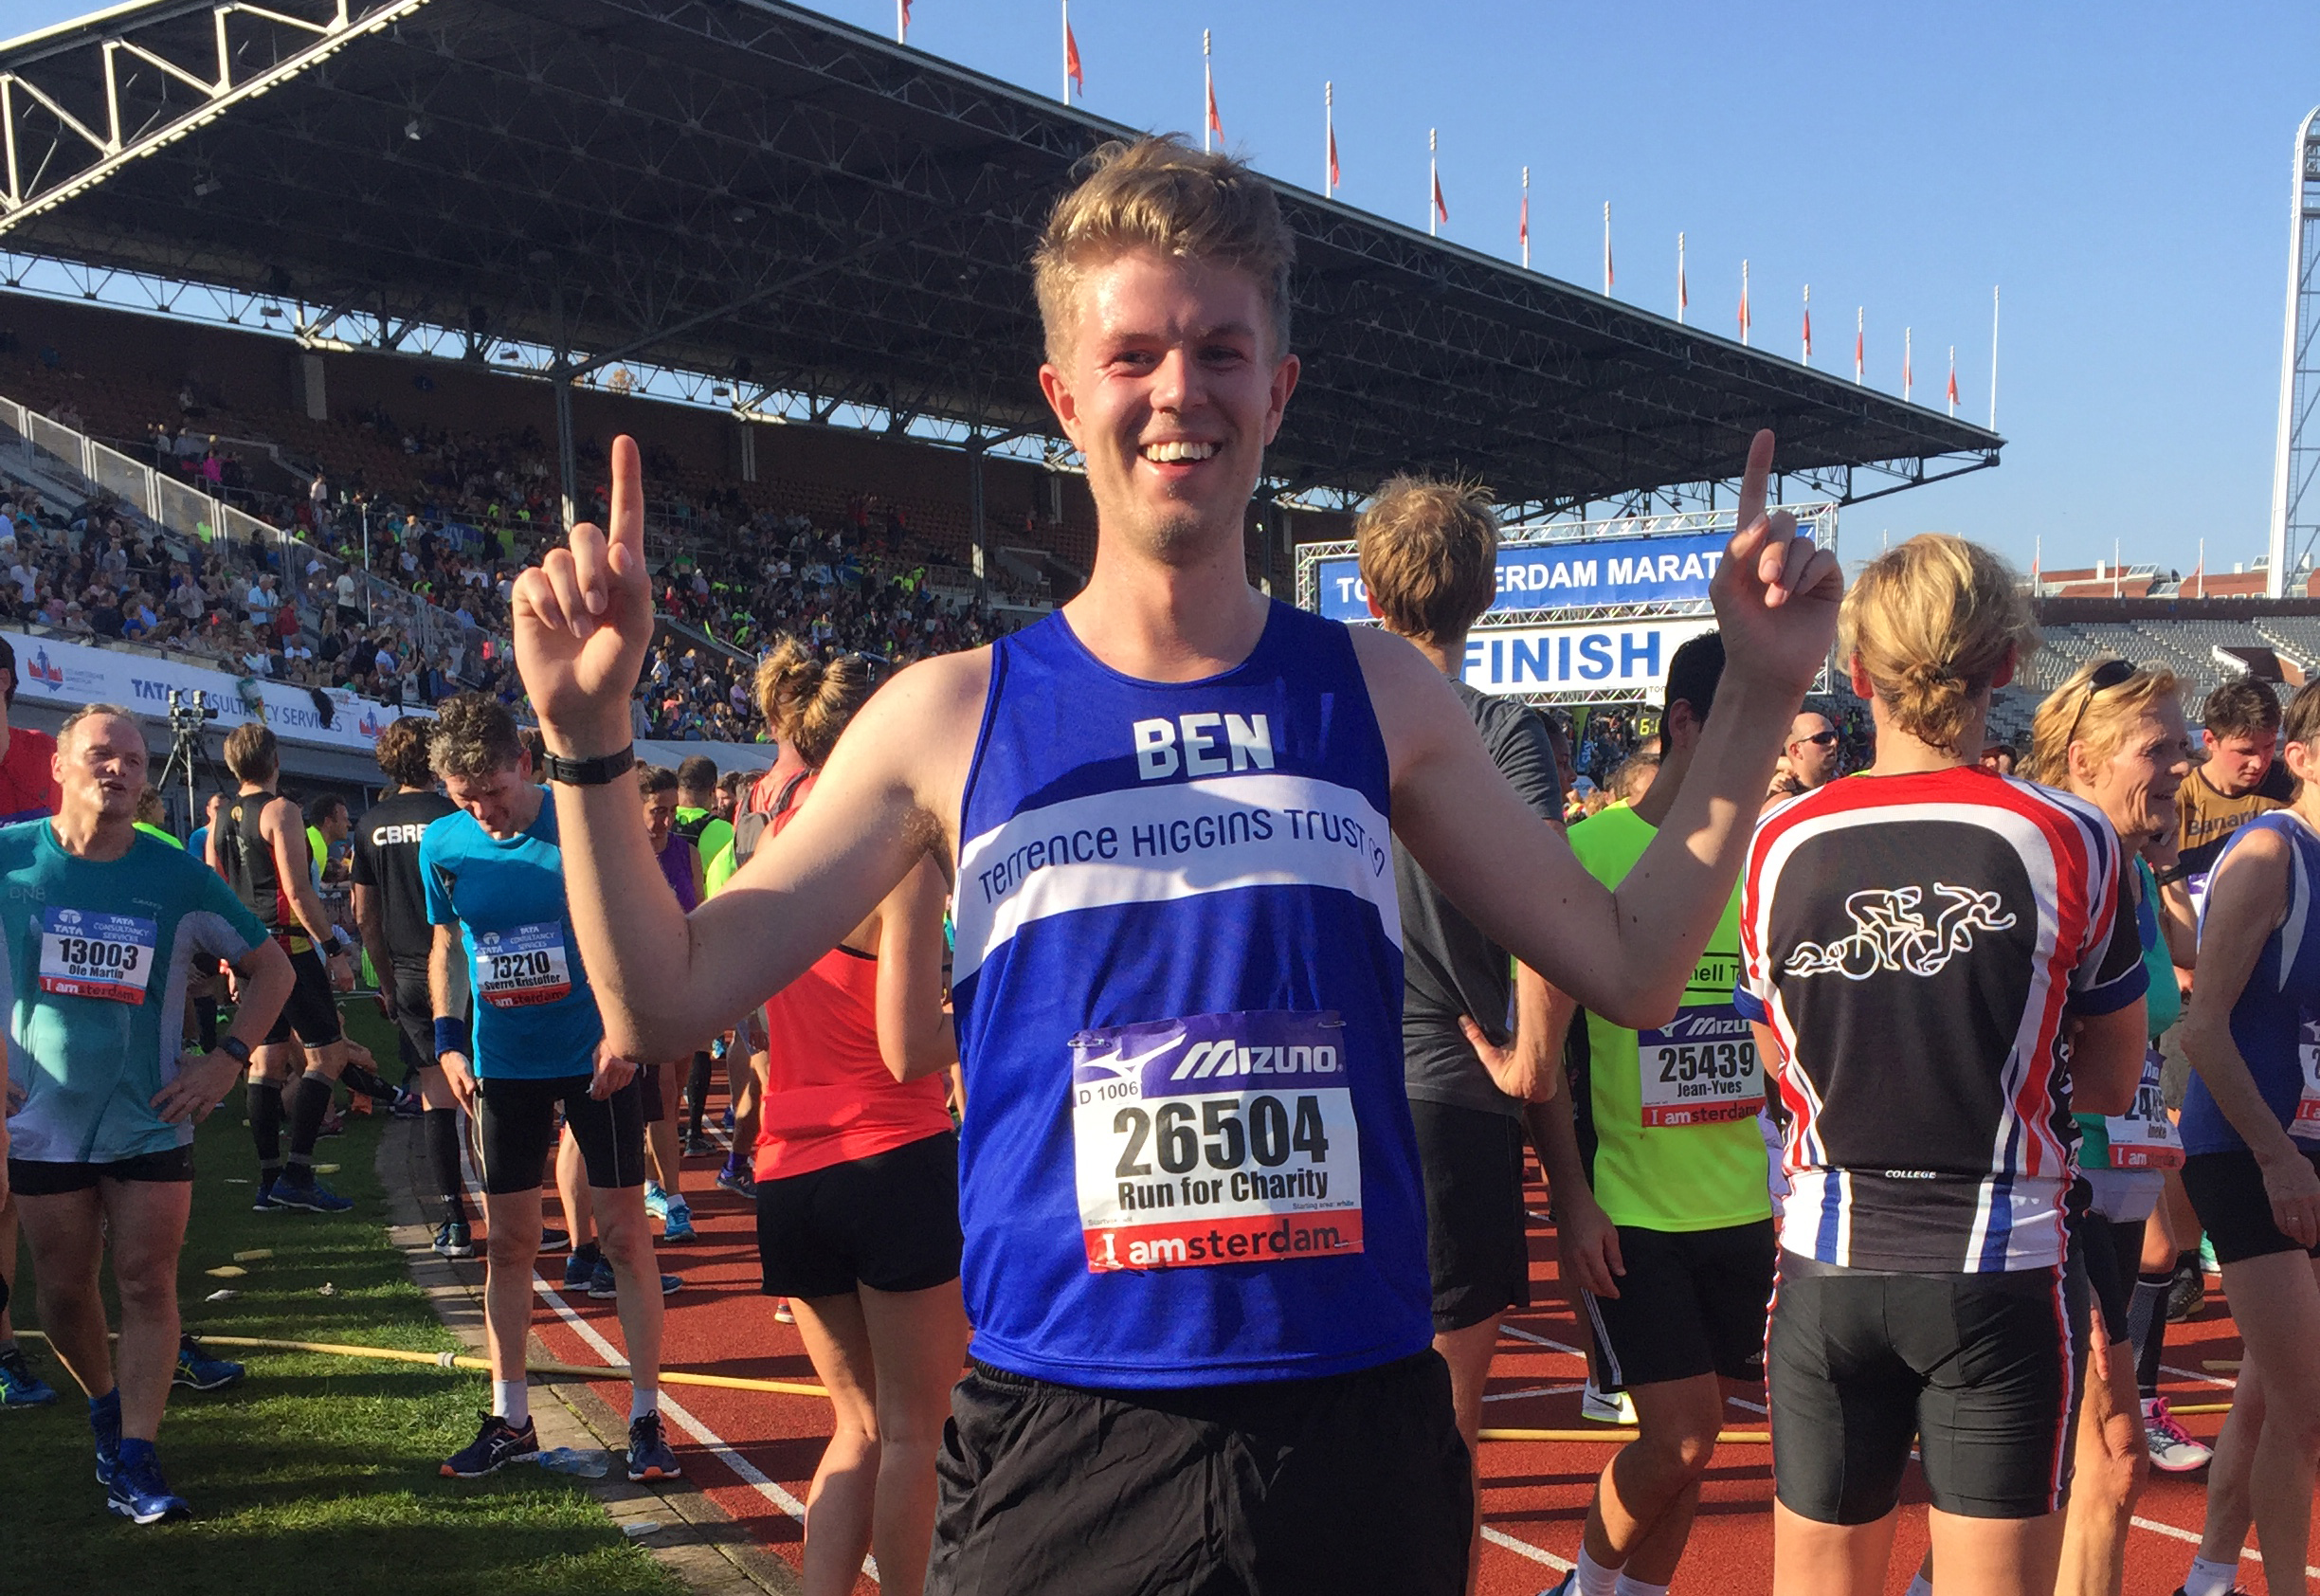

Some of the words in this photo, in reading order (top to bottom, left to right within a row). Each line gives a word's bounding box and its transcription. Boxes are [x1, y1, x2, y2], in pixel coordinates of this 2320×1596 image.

[1495, 560, 1597, 592] ERDAM
[1608, 551, 1723, 586] MARAT
[1459, 631, 1660, 684] FINISH
[181, 687, 280, 722] CNSULTACY
[1133, 713, 1275, 781] BEN
[54, 924, 83, 935] TATA
[111, 916, 134, 926] TATA
[59, 938, 138, 970] 13003
[491, 951, 551, 979] 13210
[69, 964, 86, 976] Ole
[90, 967, 124, 979] Martin
[1658, 1043, 1754, 1082] 25439
[1079, 1090, 1091, 1105] D
[1097, 1081, 1139, 1101] 1006
[1677, 1079, 1742, 1097] Jean-Yves
[1652, 1109, 1658, 1125] I
[1114, 1096, 1329, 1178] 26504
[2118, 1147, 2124, 1165] I
[1885, 1170, 1936, 1179] COLLEGE
[1118, 1181, 1173, 1212] Run
[1181, 1176, 1223, 1206] for
[1231, 1168, 1328, 1203] Charity
[1103, 1233, 1123, 1268] I
